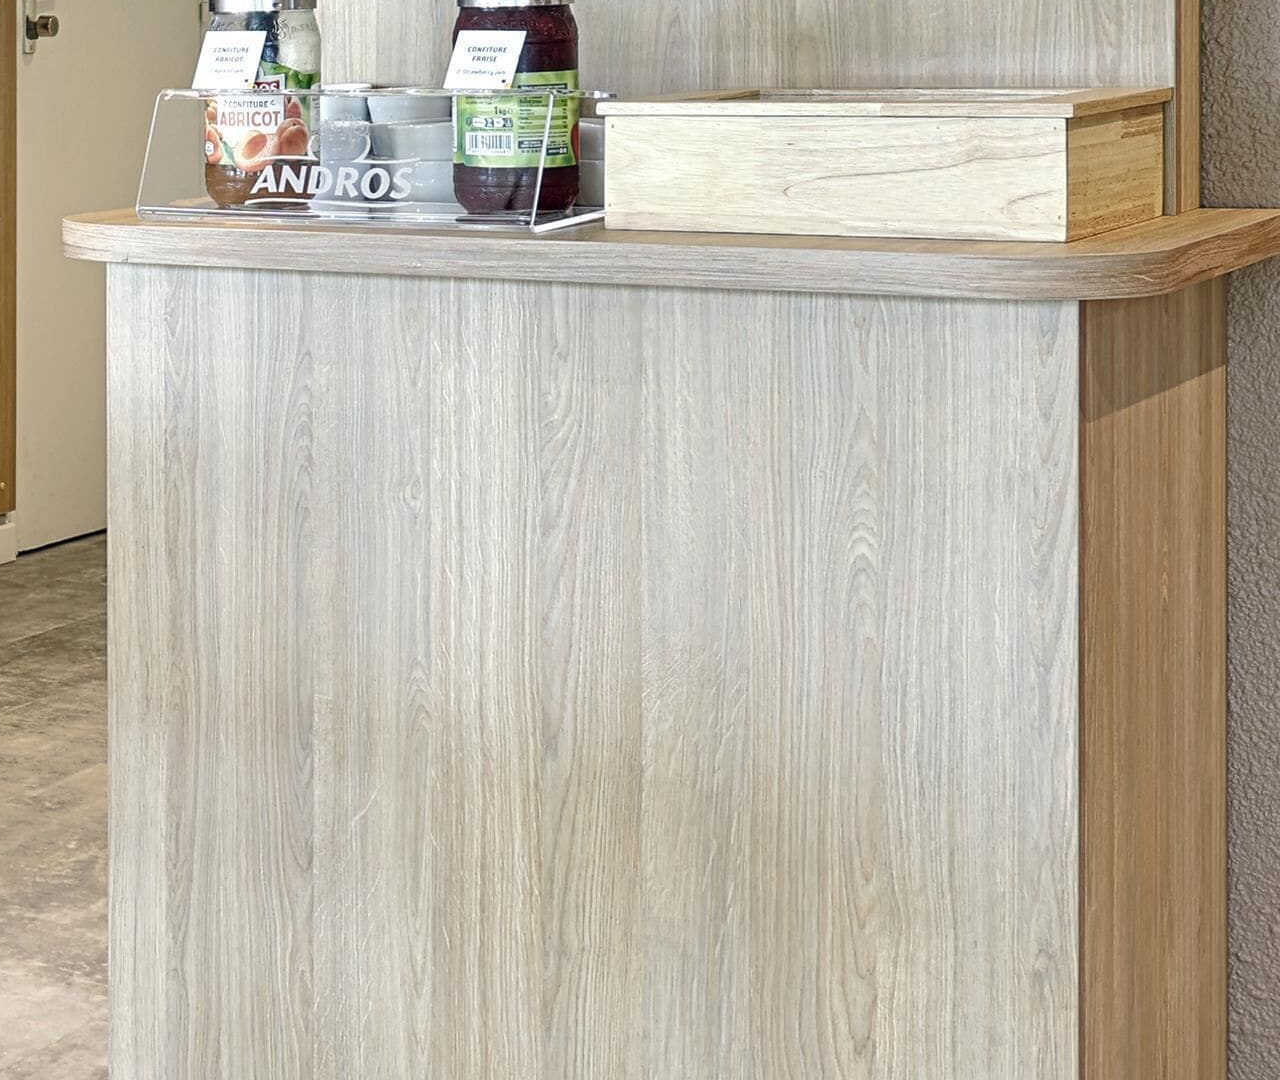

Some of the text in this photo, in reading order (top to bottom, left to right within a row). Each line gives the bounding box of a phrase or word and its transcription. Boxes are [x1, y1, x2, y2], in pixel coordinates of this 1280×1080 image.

[471, 55, 498, 63] FRAISE
[228, 100, 269, 109] CONFITURE
[220, 111, 280, 127] ABRICOT
[249, 164, 413, 200] ANDROS
